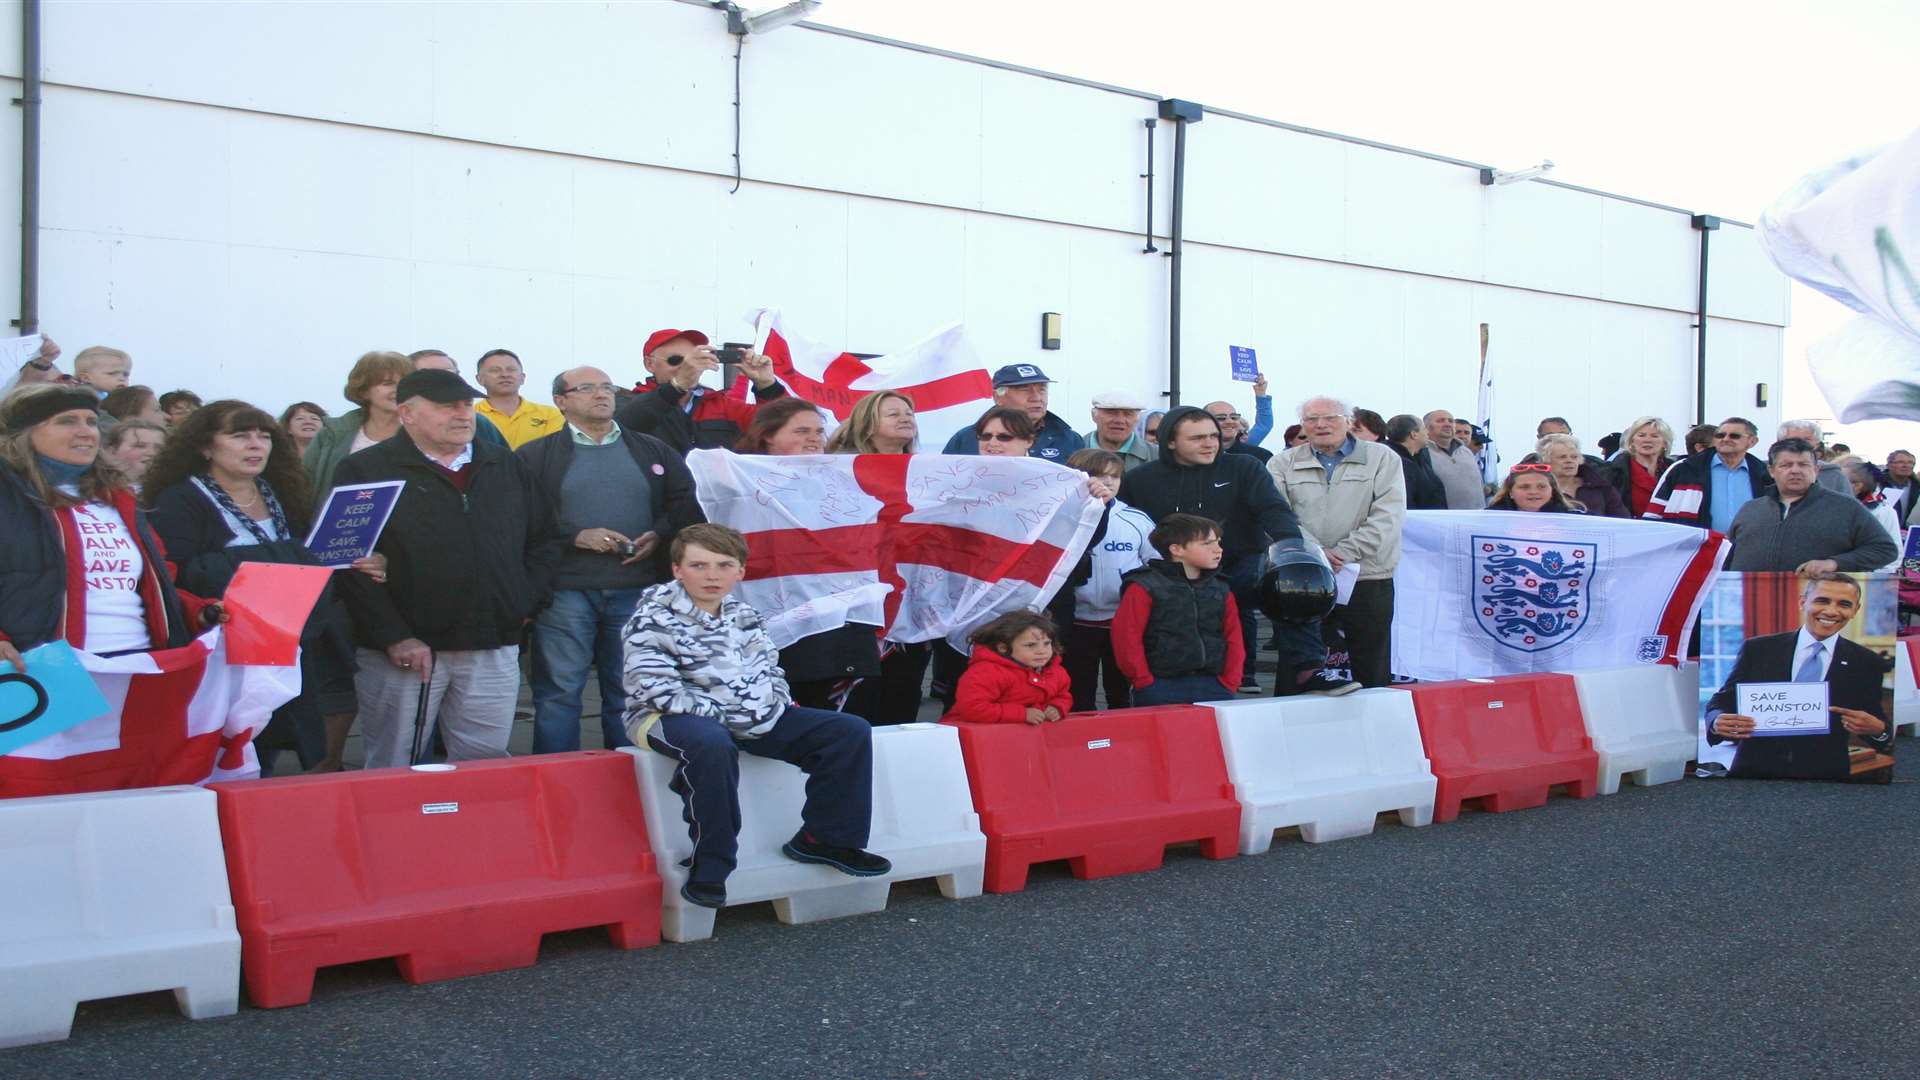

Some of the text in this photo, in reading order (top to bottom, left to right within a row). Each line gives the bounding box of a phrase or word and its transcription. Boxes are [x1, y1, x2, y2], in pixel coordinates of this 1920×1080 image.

[344, 503, 374, 515] KEEP
[79, 522, 117, 534] EEP
[336, 517, 371, 529] CALM
[86, 537, 130, 550] ALM
[328, 536, 360, 548] SAVE
[317, 547, 367, 562] ANSTON
[86, 559, 131, 573] AVE
[87, 576, 136, 591] NSTO
[1750, 692, 1787, 701] SAVE
[1751, 702, 1821, 712] MANSTON
